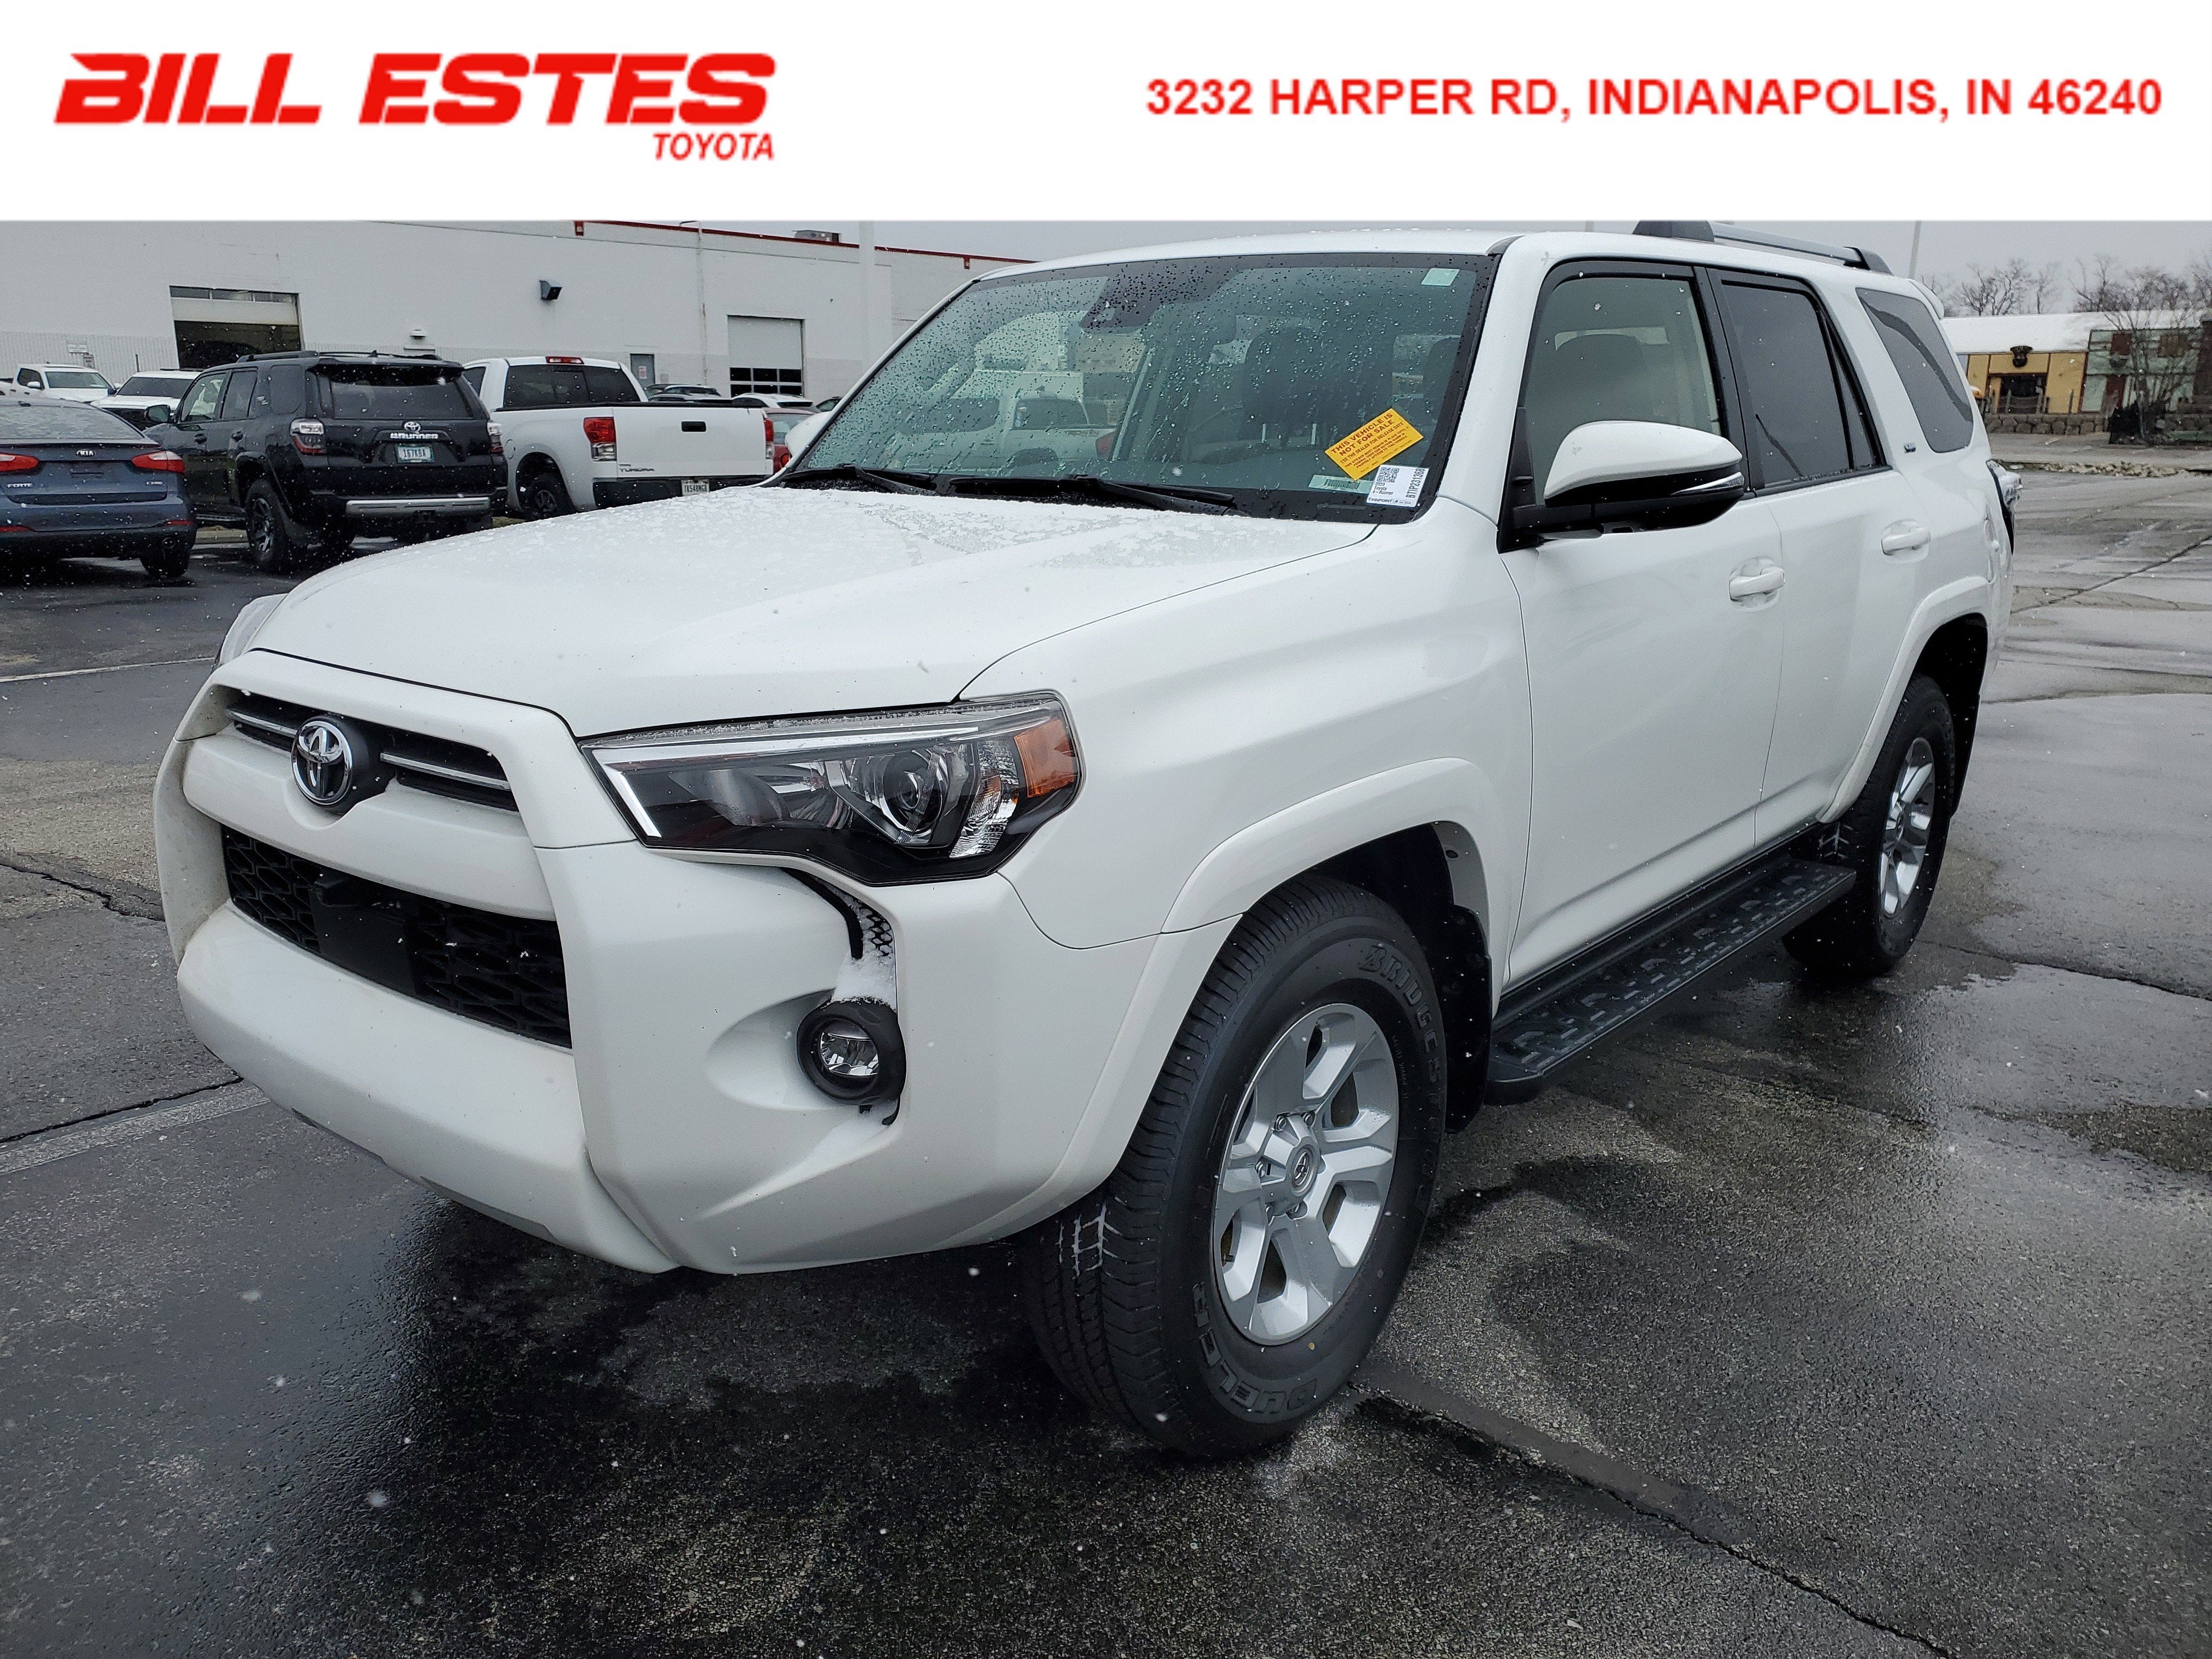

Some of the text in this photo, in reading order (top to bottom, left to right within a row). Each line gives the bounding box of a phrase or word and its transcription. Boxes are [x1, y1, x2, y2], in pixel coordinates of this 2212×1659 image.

[1331, 440, 1350, 454] THIS
[1350, 418, 1383, 441] VEHICLE
[1339, 419, 1393, 456] NOT FOR SALE
[1355, 443, 1370, 454] DEALER
[1406, 468, 1425, 498] BTIP231368
[1192, 1281, 1317, 1414] DUELER
